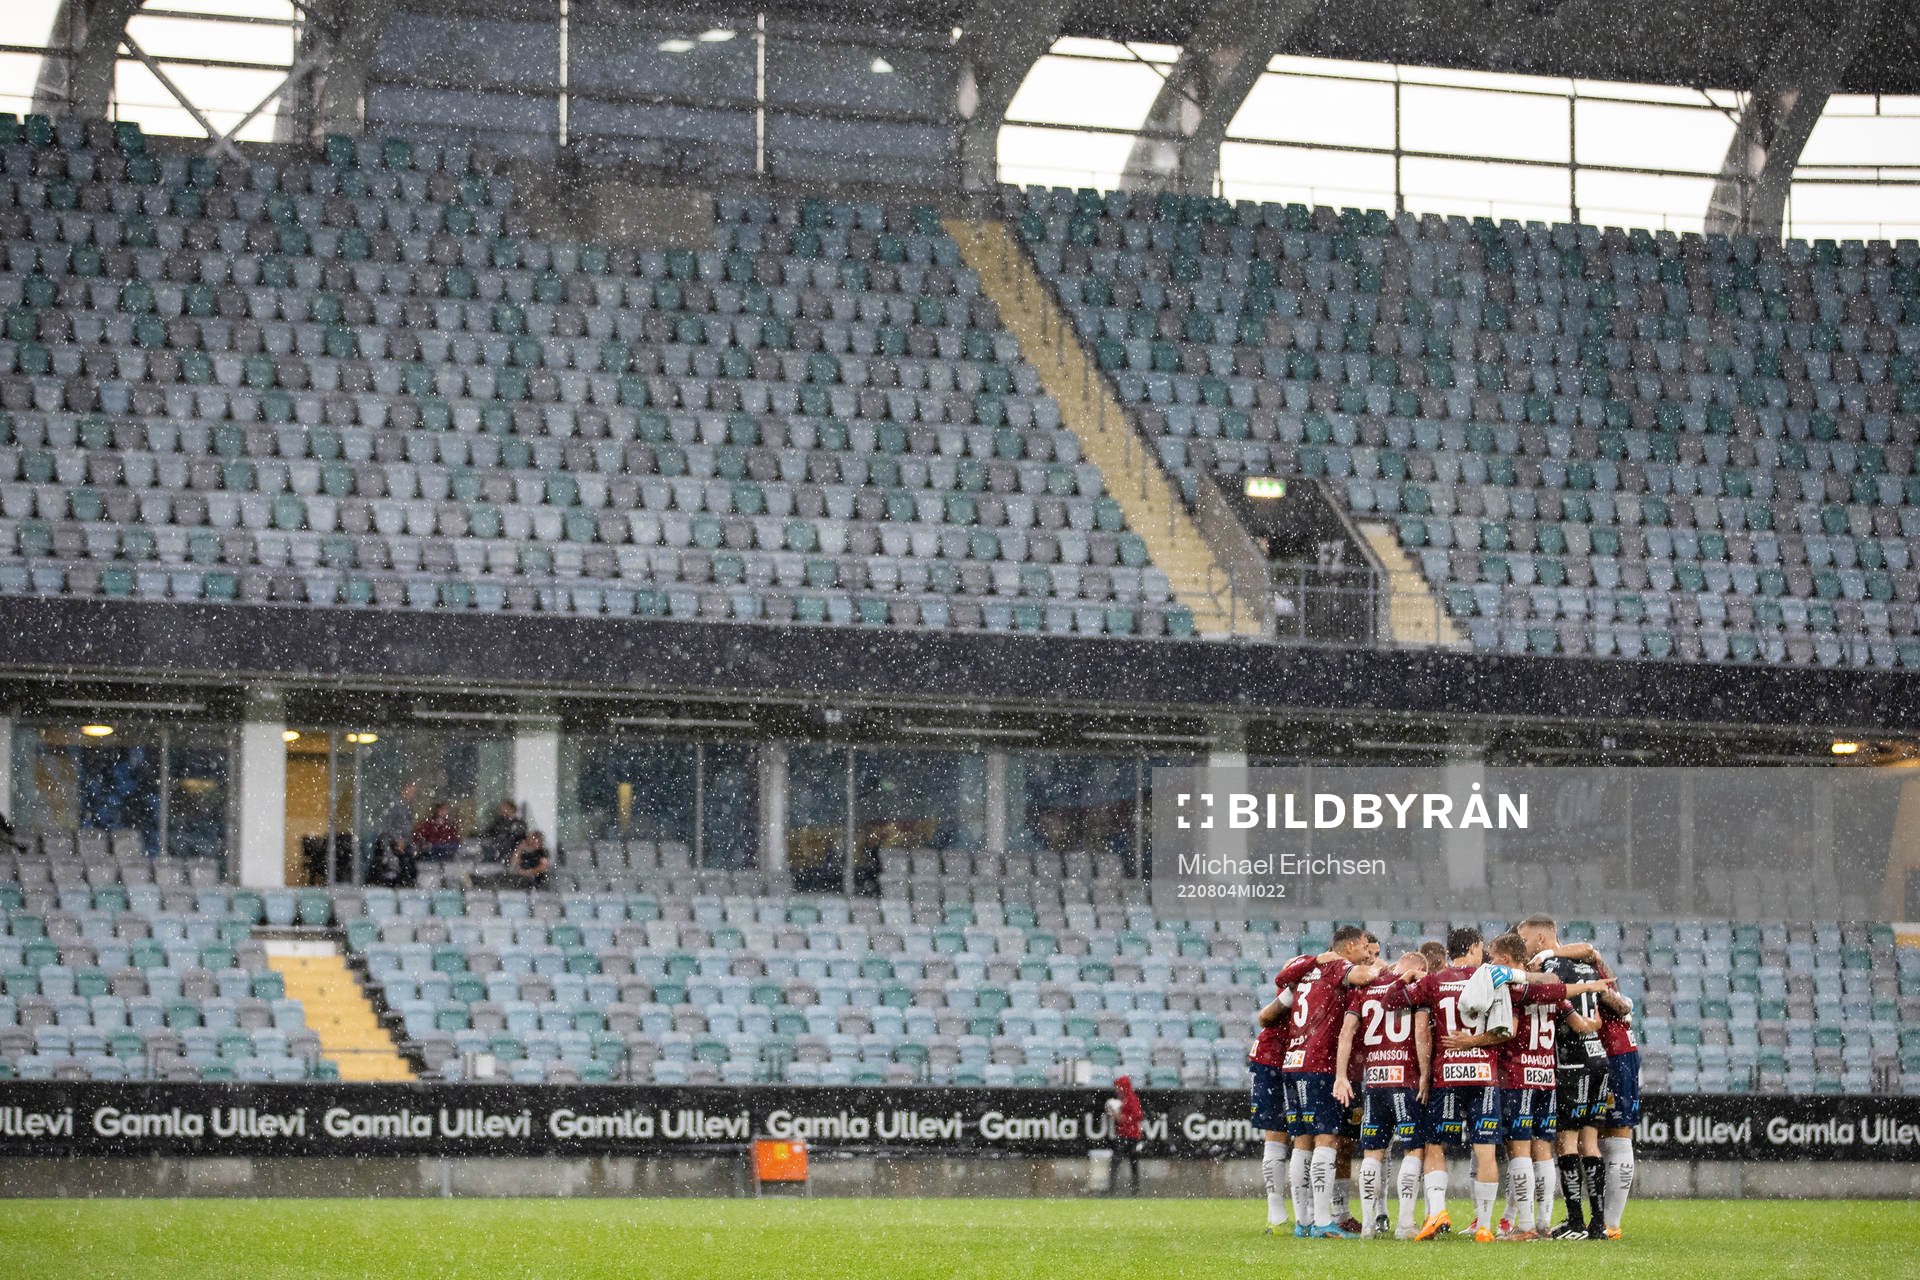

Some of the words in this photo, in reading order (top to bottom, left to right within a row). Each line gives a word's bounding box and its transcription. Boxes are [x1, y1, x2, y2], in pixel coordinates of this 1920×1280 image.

[1294, 982, 1312, 1027] 3
[1361, 1000, 1412, 1046] 20
[1524, 1003, 1556, 1050] 15
[1367, 1069, 1389, 1081] ESAB
[1444, 1065, 1477, 1079] BESAB
[1526, 1069, 1553, 1084] BESAB
[94, 1106, 204, 1138] Gamla
[212, 1107, 306, 1138] Ullevi
[323, 1107, 432, 1139] Gamla
[440, 1108, 532, 1139] Ullevi
[549, 1109, 655, 1139] Gamla
[660, 1109, 751, 1139] Ullevi
[767, 1109, 870, 1139] Gamla
[875, 1110, 964, 1140] Ullevi
[979, 1111, 1078, 1141] Gamla
[1674, 1115, 1753, 1144] Ullevi
[1766, 1116, 1855, 1145] Gamla
[1861, 1116, 1920, 1146] Ulle
[1263, 1160, 1275, 1194] MIKE
[1312, 1161, 1326, 1192] MIKE
[1363, 1170, 1376, 1201] MIKE
[1401, 1173, 1414, 1199] MIKE
[1513, 1173, 1528, 1202] MIKE
[1534, 1176, 1545, 1202] MIKE
[1563, 1169, 1581, 1200] MIKE
[1619, 1162, 1634, 1190] MIKE
